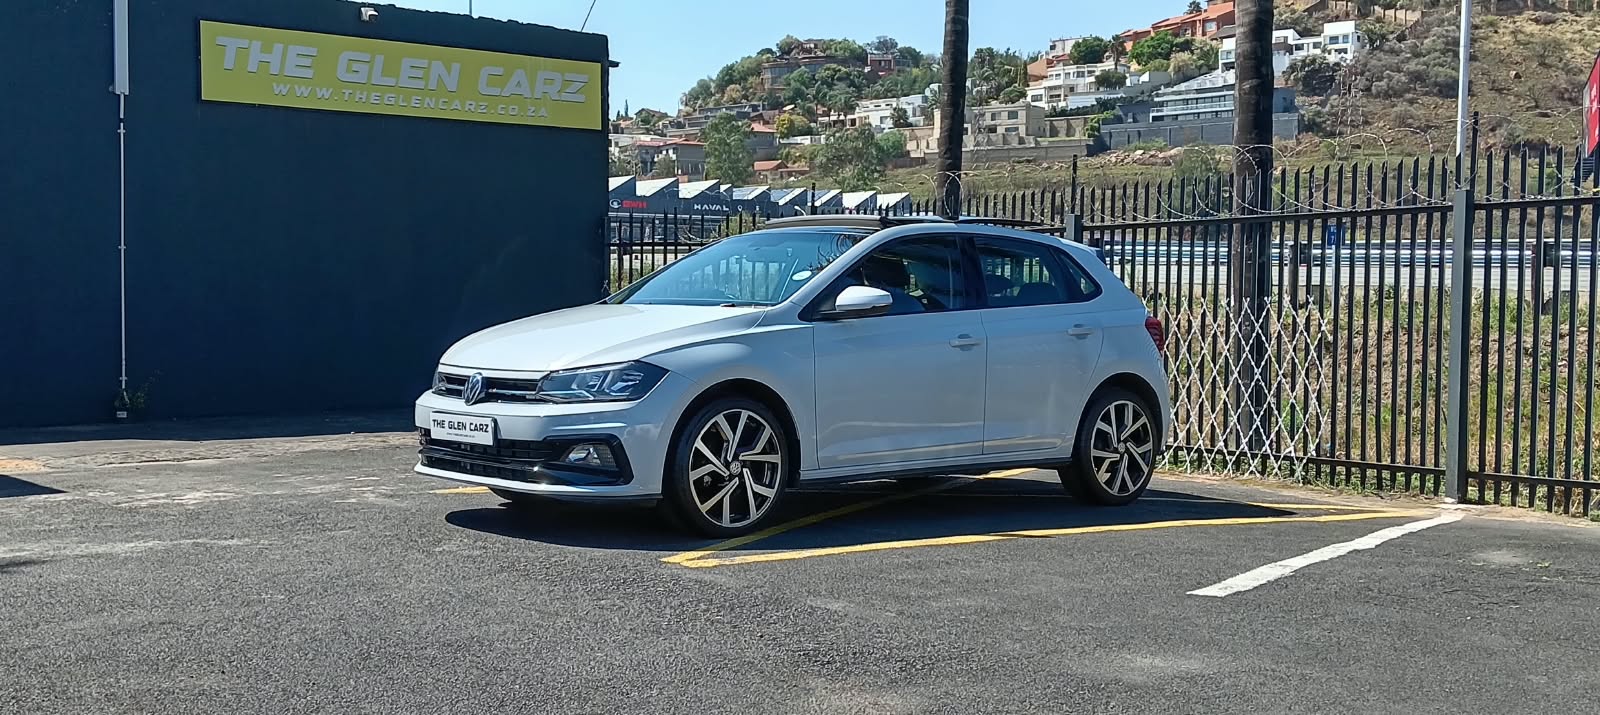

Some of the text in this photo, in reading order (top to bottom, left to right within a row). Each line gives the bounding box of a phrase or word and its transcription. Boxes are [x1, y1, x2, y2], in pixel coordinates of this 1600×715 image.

[216, 36, 589, 103] THE GLEN CARZ
[272, 82, 548, 118] WWW.THEGLENCARZ.CO.ZA
[694, 203, 730, 211] HAVAL
[432, 419, 489, 433] THE GLEN CARZ
